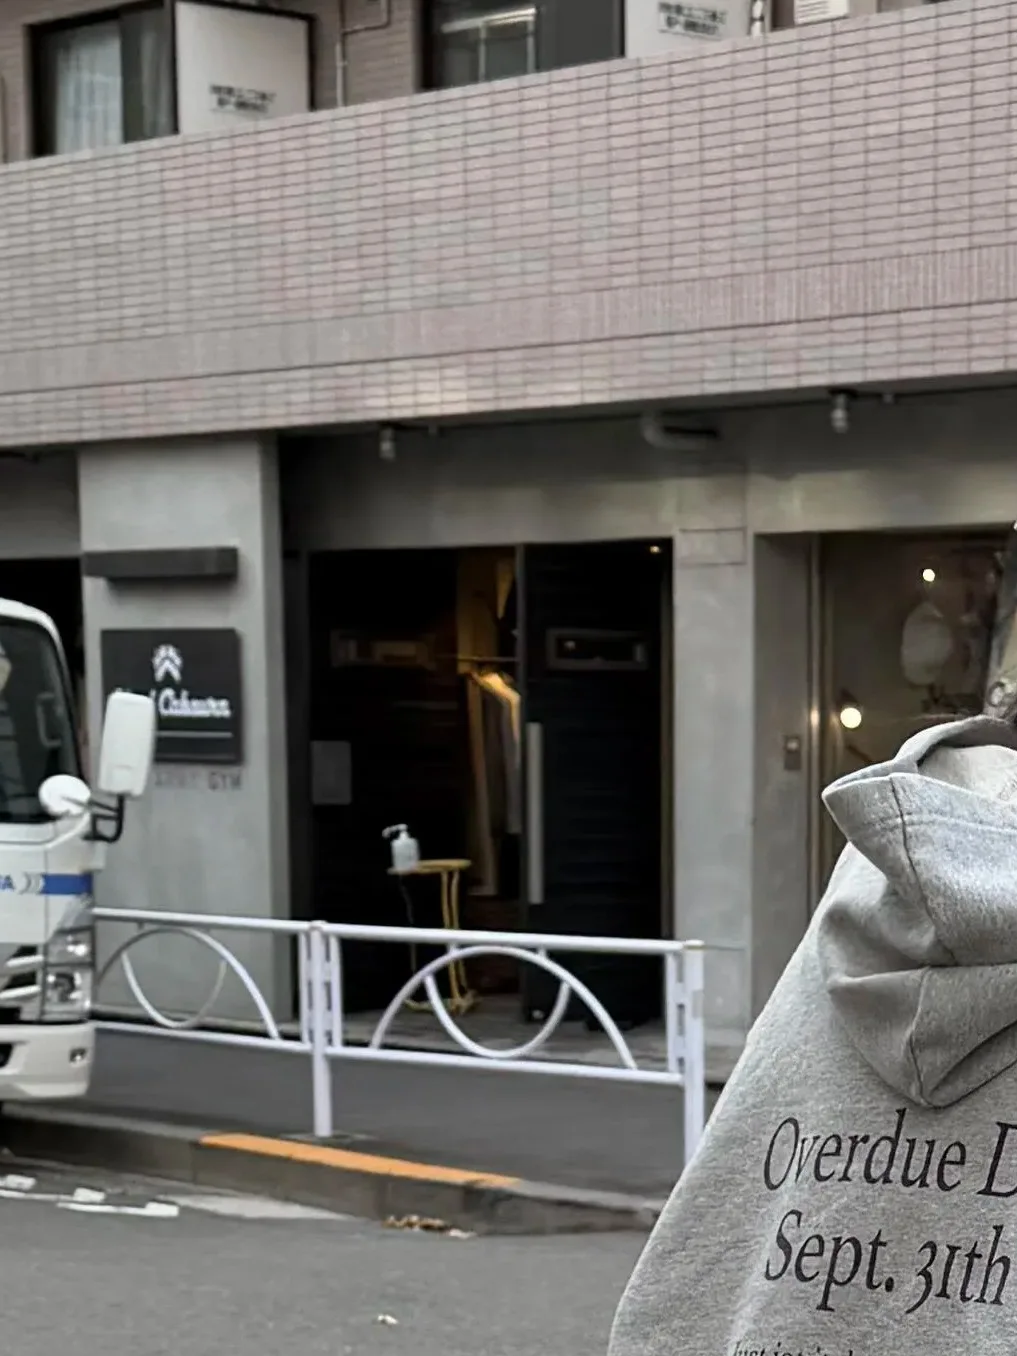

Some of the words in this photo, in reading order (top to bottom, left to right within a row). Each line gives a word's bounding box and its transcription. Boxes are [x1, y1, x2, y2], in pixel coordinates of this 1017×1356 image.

[764, 1108, 967, 1192] Overdue
[765, 1209, 895, 1312] Sept.
[905, 1224, 1011, 1314] 31th
